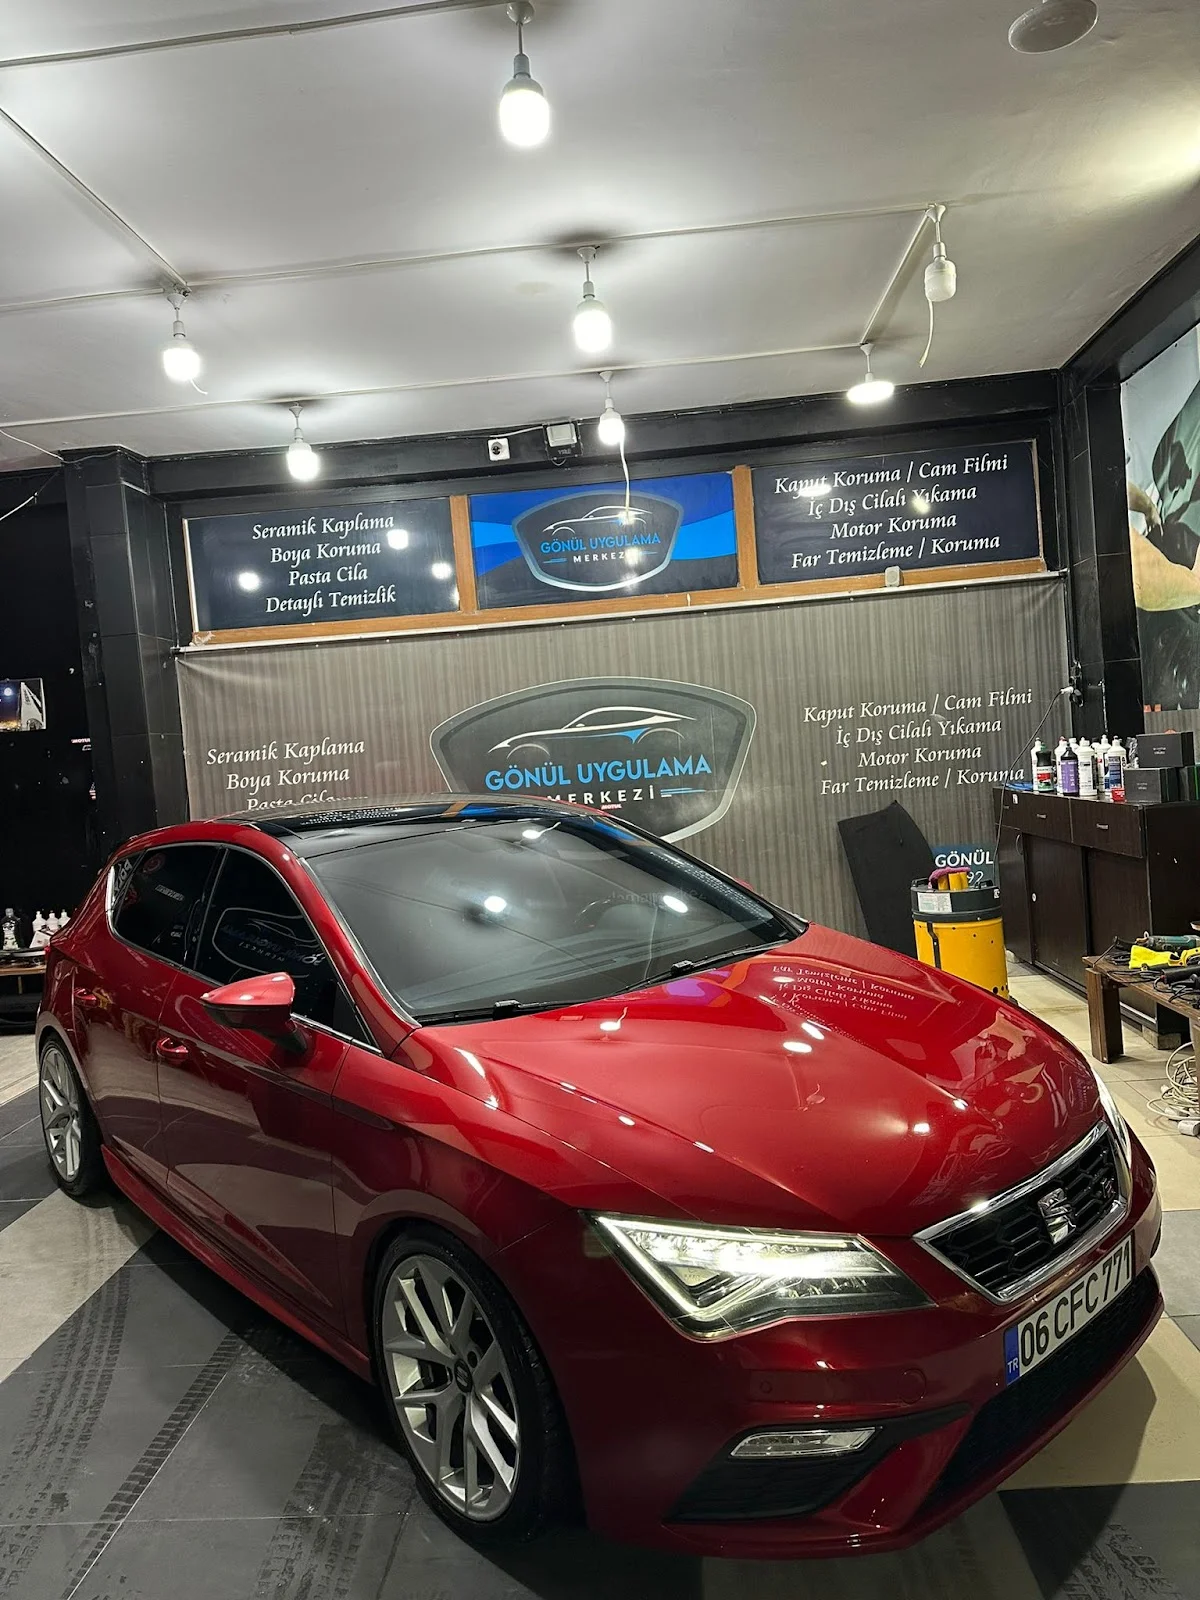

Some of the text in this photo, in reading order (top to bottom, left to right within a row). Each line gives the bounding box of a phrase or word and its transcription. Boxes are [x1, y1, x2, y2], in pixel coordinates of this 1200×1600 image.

[833, 468, 901, 488] Koruma
[906, 461, 914, 483] /
[918, 462, 957, 479] Cam
[962, 452, 1008, 475] Filmi
[808, 496, 824, 520] İç
[828, 497, 857, 516] Dış
[862, 488, 906, 510] Cilalı
[252, 512, 394, 540] Seramik Kaplama
[830, 514, 957, 540] Motor Koruma
[270, 542, 381, 568] Boya Koruma
[540, 532, 661, 554] GÖNÜL UYGULAMA
[791, 536, 1000, 569] Far Temizleme / Koruma
[288, 562, 368, 586] Pasta Cila
[266, 584, 396, 617] Detaylı Temizlik
[803, 686, 1032, 728] Kaput Koruma / Cam Filmi
[836, 716, 1002, 748] İç Dış Cilalı Yıkama
[206, 736, 365, 766] Seramik Kaplama
[857, 746, 982, 768] Motor Koruma
[226, 768, 350, 796] Boya Koruma
[484, 754, 712, 792] GÖNÜL UYGULAMA
[820, 768, 1025, 795] Far Temizleme / Koruma
[934, 848, 994, 868] GÖNÜL
[1020, 1240, 1131, 1367] 06 CFC 771
[1007, 1357, 1019, 1374] TR
